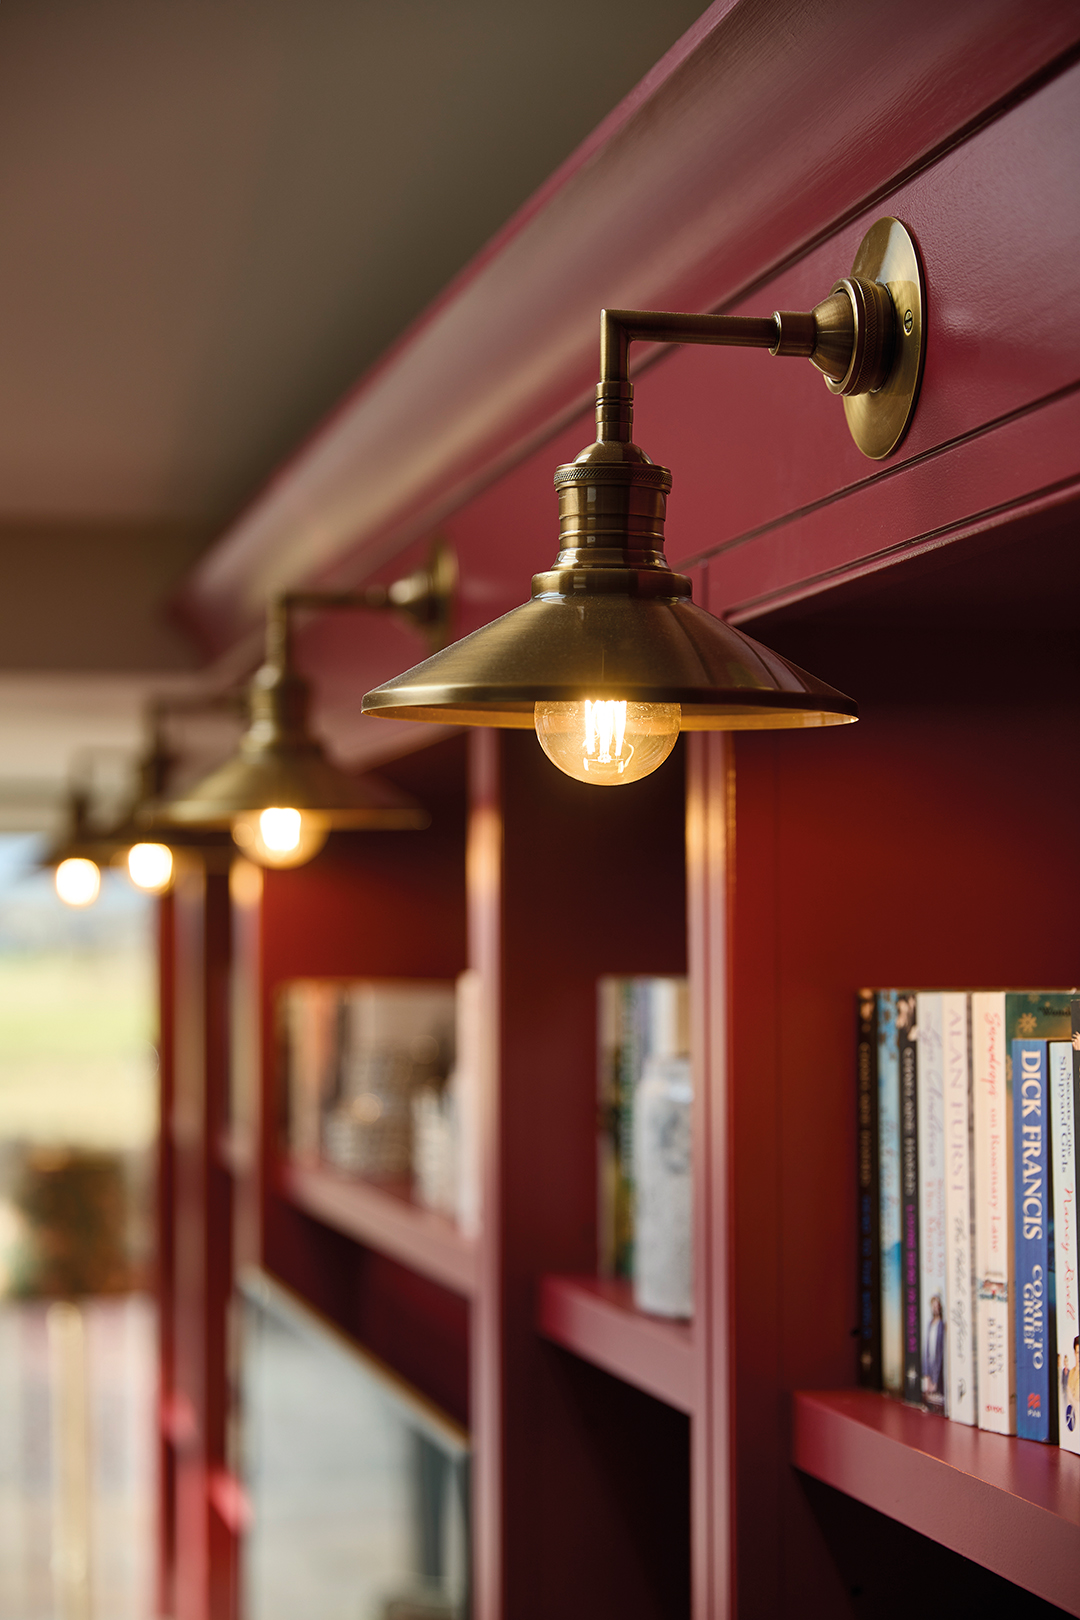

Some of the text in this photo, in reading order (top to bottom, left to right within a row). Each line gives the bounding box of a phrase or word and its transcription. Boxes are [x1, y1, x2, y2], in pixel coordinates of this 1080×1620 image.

[949, 1008, 965, 1191] ALAN FURST
[990, 1107, 997, 1128] on
[1059, 1056, 1069, 1173] Shipyard Girls
[990, 1135, 1001, 1208] Rosemary
[1021, 1049, 1043, 1240] DICK FRANCIS
[992, 1215, 1001, 1253] Lane
[1061, 1182, 1074, 1252] Nancy
[988, 1317, 997, 1378] BERRY
[1023, 1282, 1035, 1351] GRIEF
[1032, 1264, 1044, 1370] COME TO
